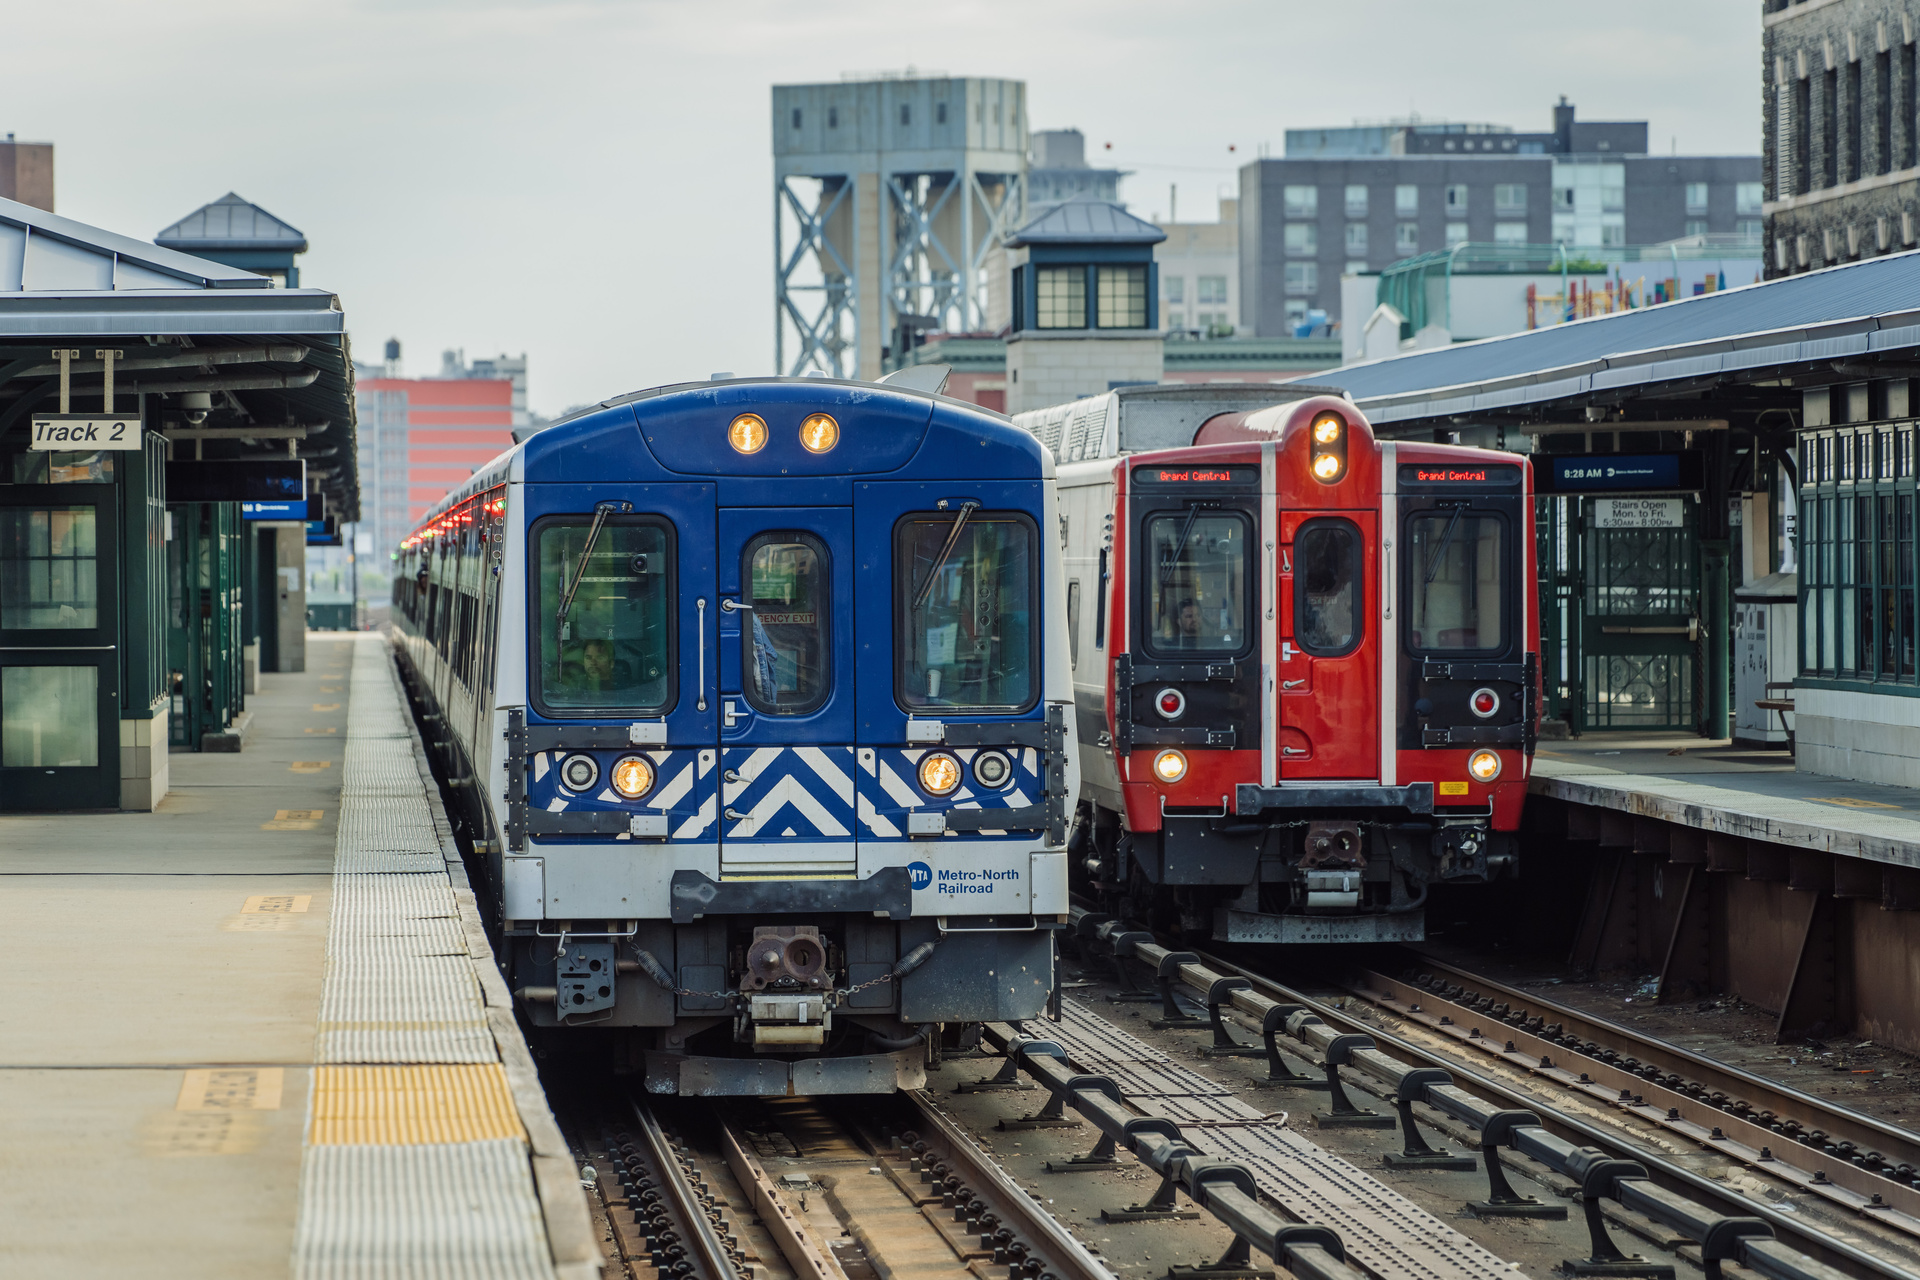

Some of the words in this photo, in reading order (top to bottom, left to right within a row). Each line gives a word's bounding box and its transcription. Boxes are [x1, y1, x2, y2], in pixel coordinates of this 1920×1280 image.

[35, 422, 99, 441] Track
[109, 422, 126, 441] 2
[1160, 471, 1189, 481] Grand
[1192, 471, 1231, 481] Central
[1418, 470, 1446, 480] Grand
[1449, 470, 1486, 480] Central
[1564, 469, 1585, 478] 8:28
[1586, 469, 1602, 478] AM
[1611, 501, 1639, 510] Stairs
[1641, 501, 1667, 511] Open
[1612, 509, 1636, 518] Mon.
[1639, 510, 1649, 518] to
[1651, 509, 1666, 518] Fri.
[1603, 518, 1634, 527] 5:30AM
[758, 614, 790, 623] GENCY
[792, 614, 814, 623] EXIT
[908, 869, 928, 882] MTA
[938, 869, 1019, 880] Metro-North
[938, 883, 993, 894] Railroad
